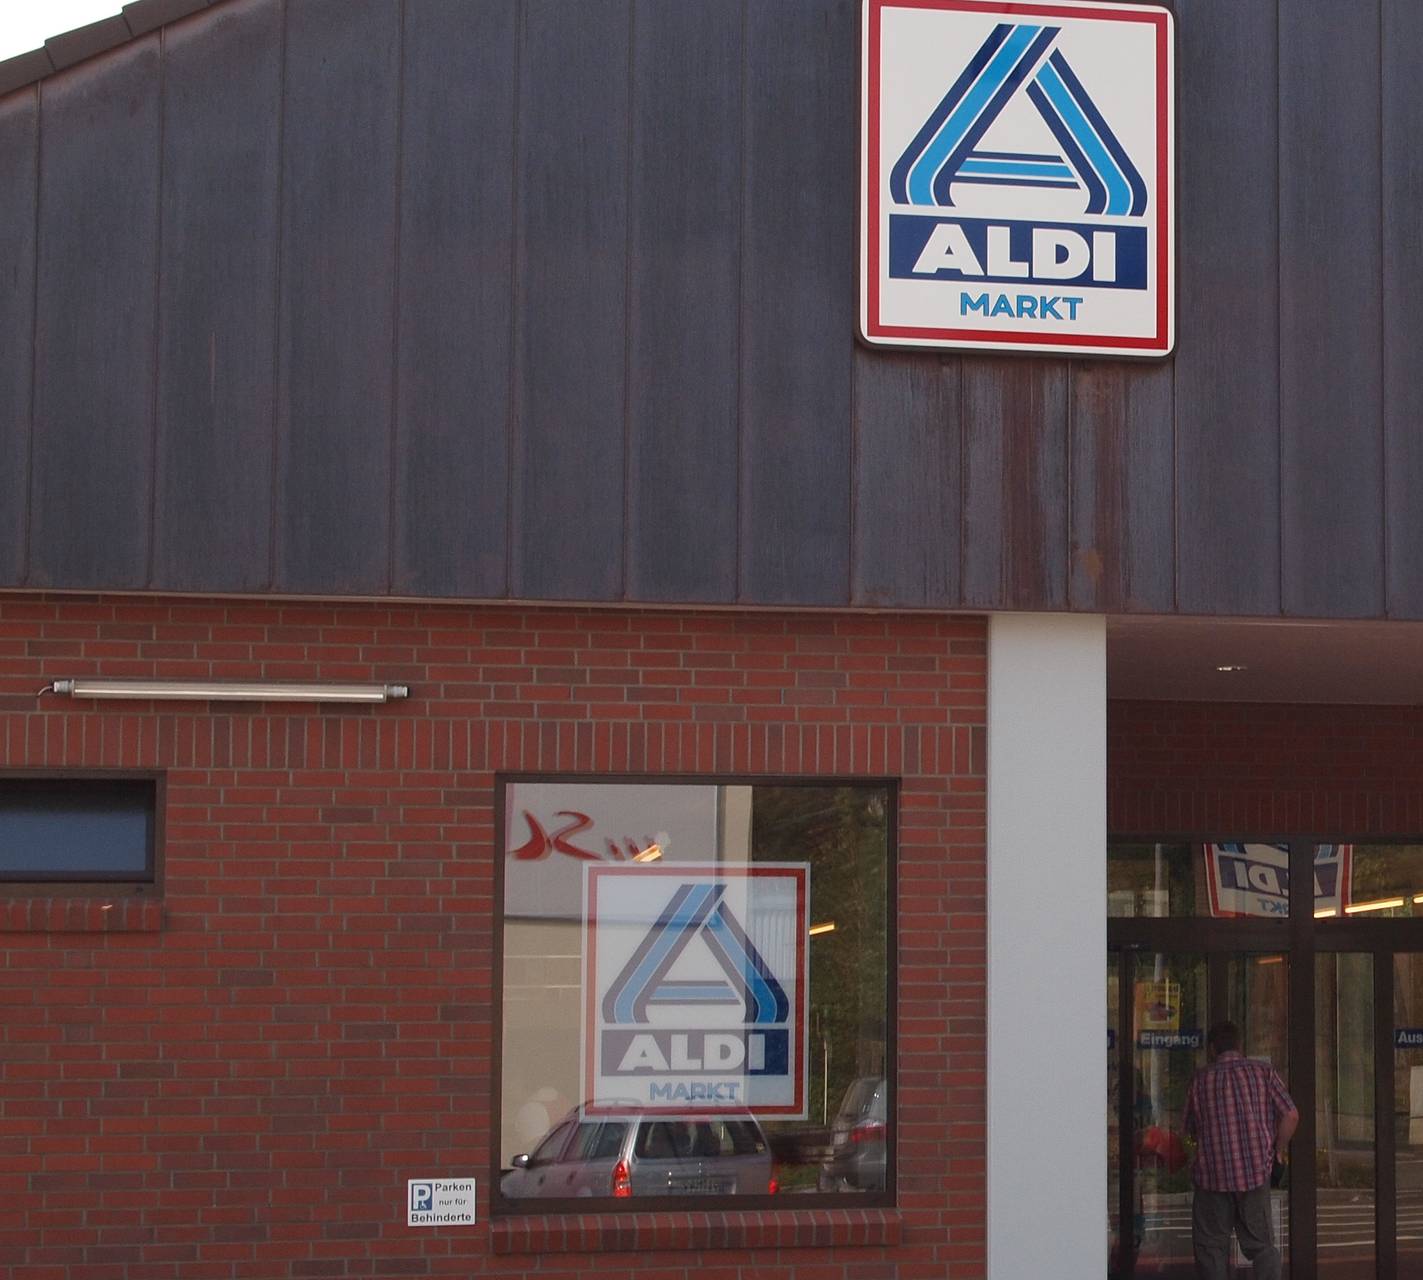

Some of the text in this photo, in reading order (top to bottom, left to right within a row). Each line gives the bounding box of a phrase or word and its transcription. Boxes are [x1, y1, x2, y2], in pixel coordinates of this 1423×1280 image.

[911, 223, 1116, 282] ALDI
[960, 292, 1083, 320] MARKT
[1141, 1032, 1200, 1048] Eingang
[617, 1034, 766, 1071] ALDI
[650, 1082, 740, 1100] MARKT
[435, 1182, 472, 1192] Parken
[455, 1197, 466, 1206] für
[411, 1213, 472, 1223] Behinderte
